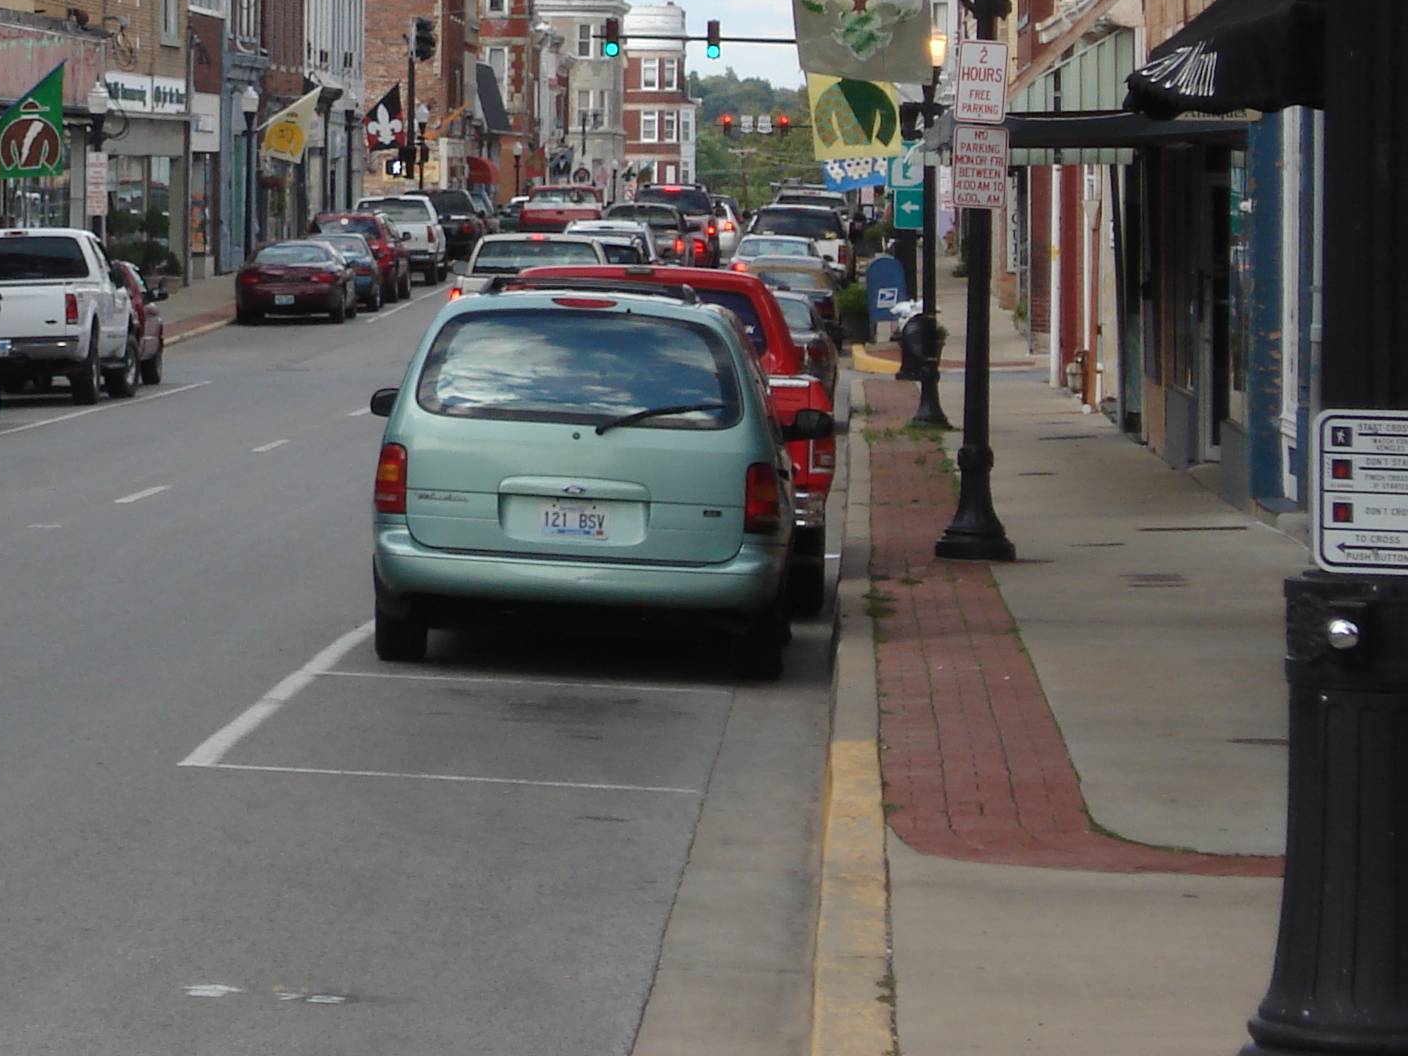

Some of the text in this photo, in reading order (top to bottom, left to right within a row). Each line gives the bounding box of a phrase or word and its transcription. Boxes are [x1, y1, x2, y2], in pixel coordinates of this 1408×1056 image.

[979, 49, 988, 64] 2
[962, 66, 1003, 83] HOURS
[970, 89, 991, 101] FREE
[962, 102, 999, 115] PARKING
[975, 130, 988, 140] NO
[960, 142, 1000, 154] PARKING
[955, 155, 1005, 167] MON OR FRI
[959, 167, 1001, 179] BETWEEN
[978, 181, 990, 192] AM
[993, 182, 1004, 192] TO
[987, 194, 1000, 204] AM
[1358, 423, 1408, 433] START CROS
[1392, 458, 1408, 467] STA
[1392, 508, 1408, 516] CRO
[544, 511, 605, 530] 121 BSV
[1355, 534, 1401, 544] TO CROSS
[1346, 552, 1371, 561] PUSH
